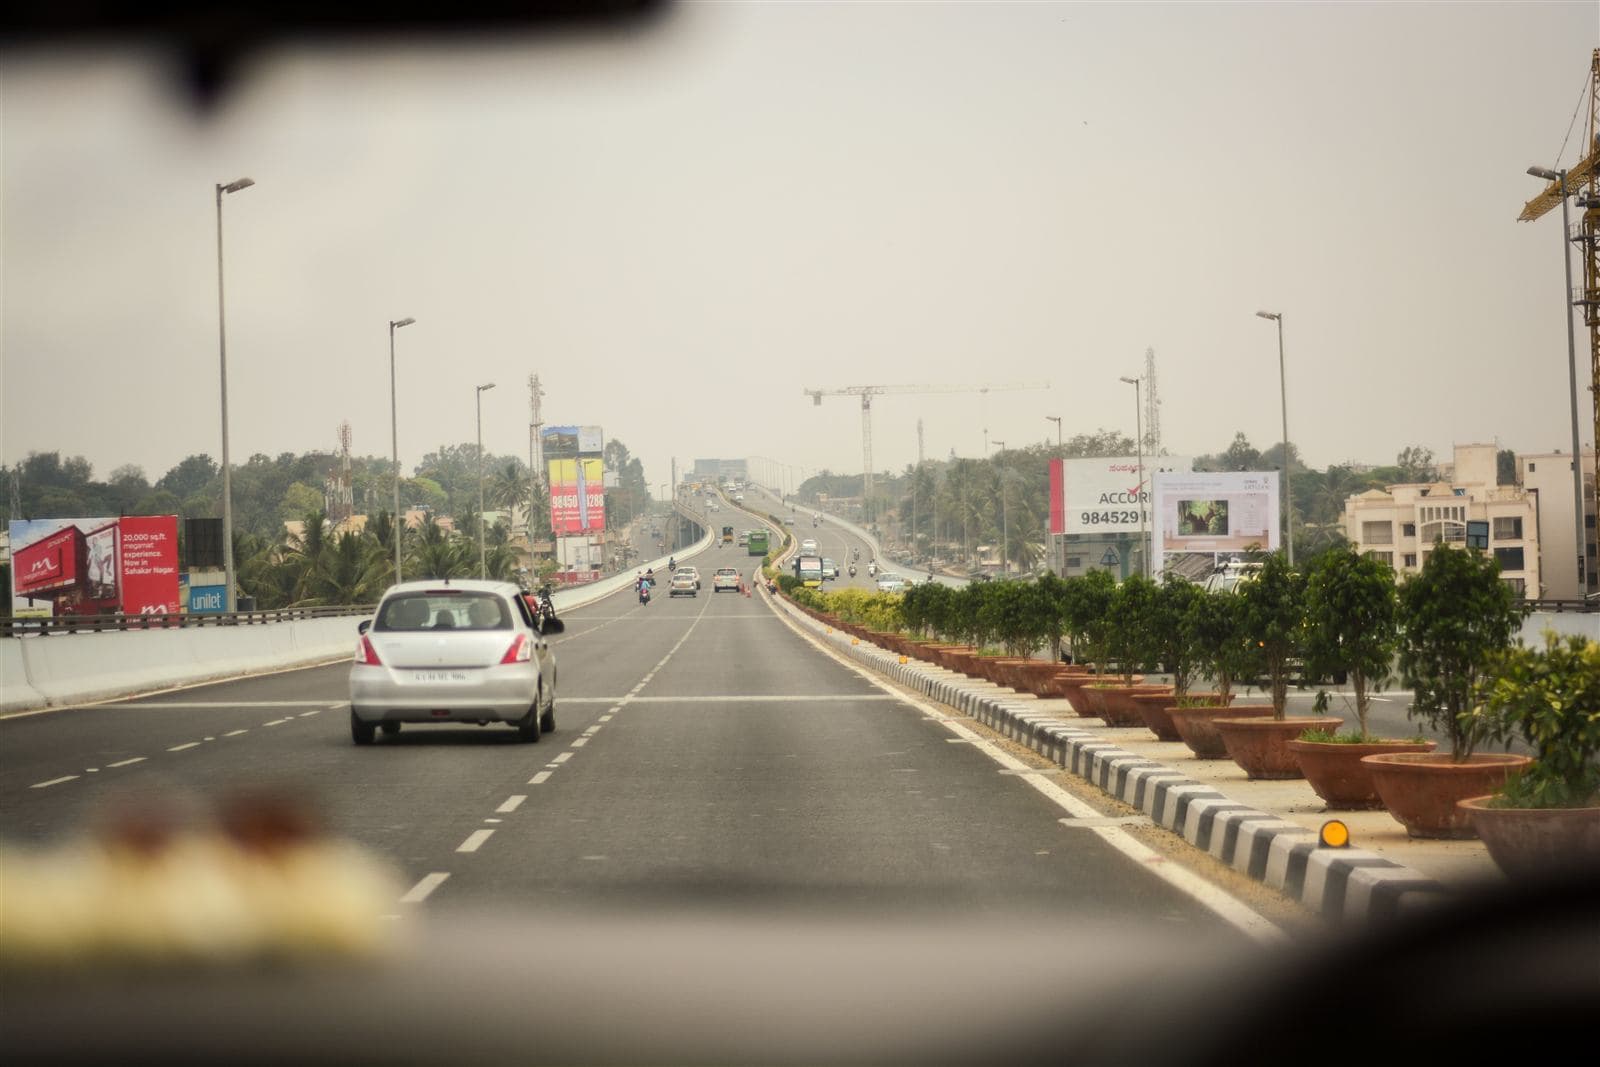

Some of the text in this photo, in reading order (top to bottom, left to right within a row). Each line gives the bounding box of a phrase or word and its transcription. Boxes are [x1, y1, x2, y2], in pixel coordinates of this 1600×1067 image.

[1098, 491, 1151, 505] ACCOR
[1081, 511, 1151, 525] 9845291
[123, 533, 148, 543] 20,000
[124, 558, 148, 567] Now in
[192, 591, 221, 611] unilet
